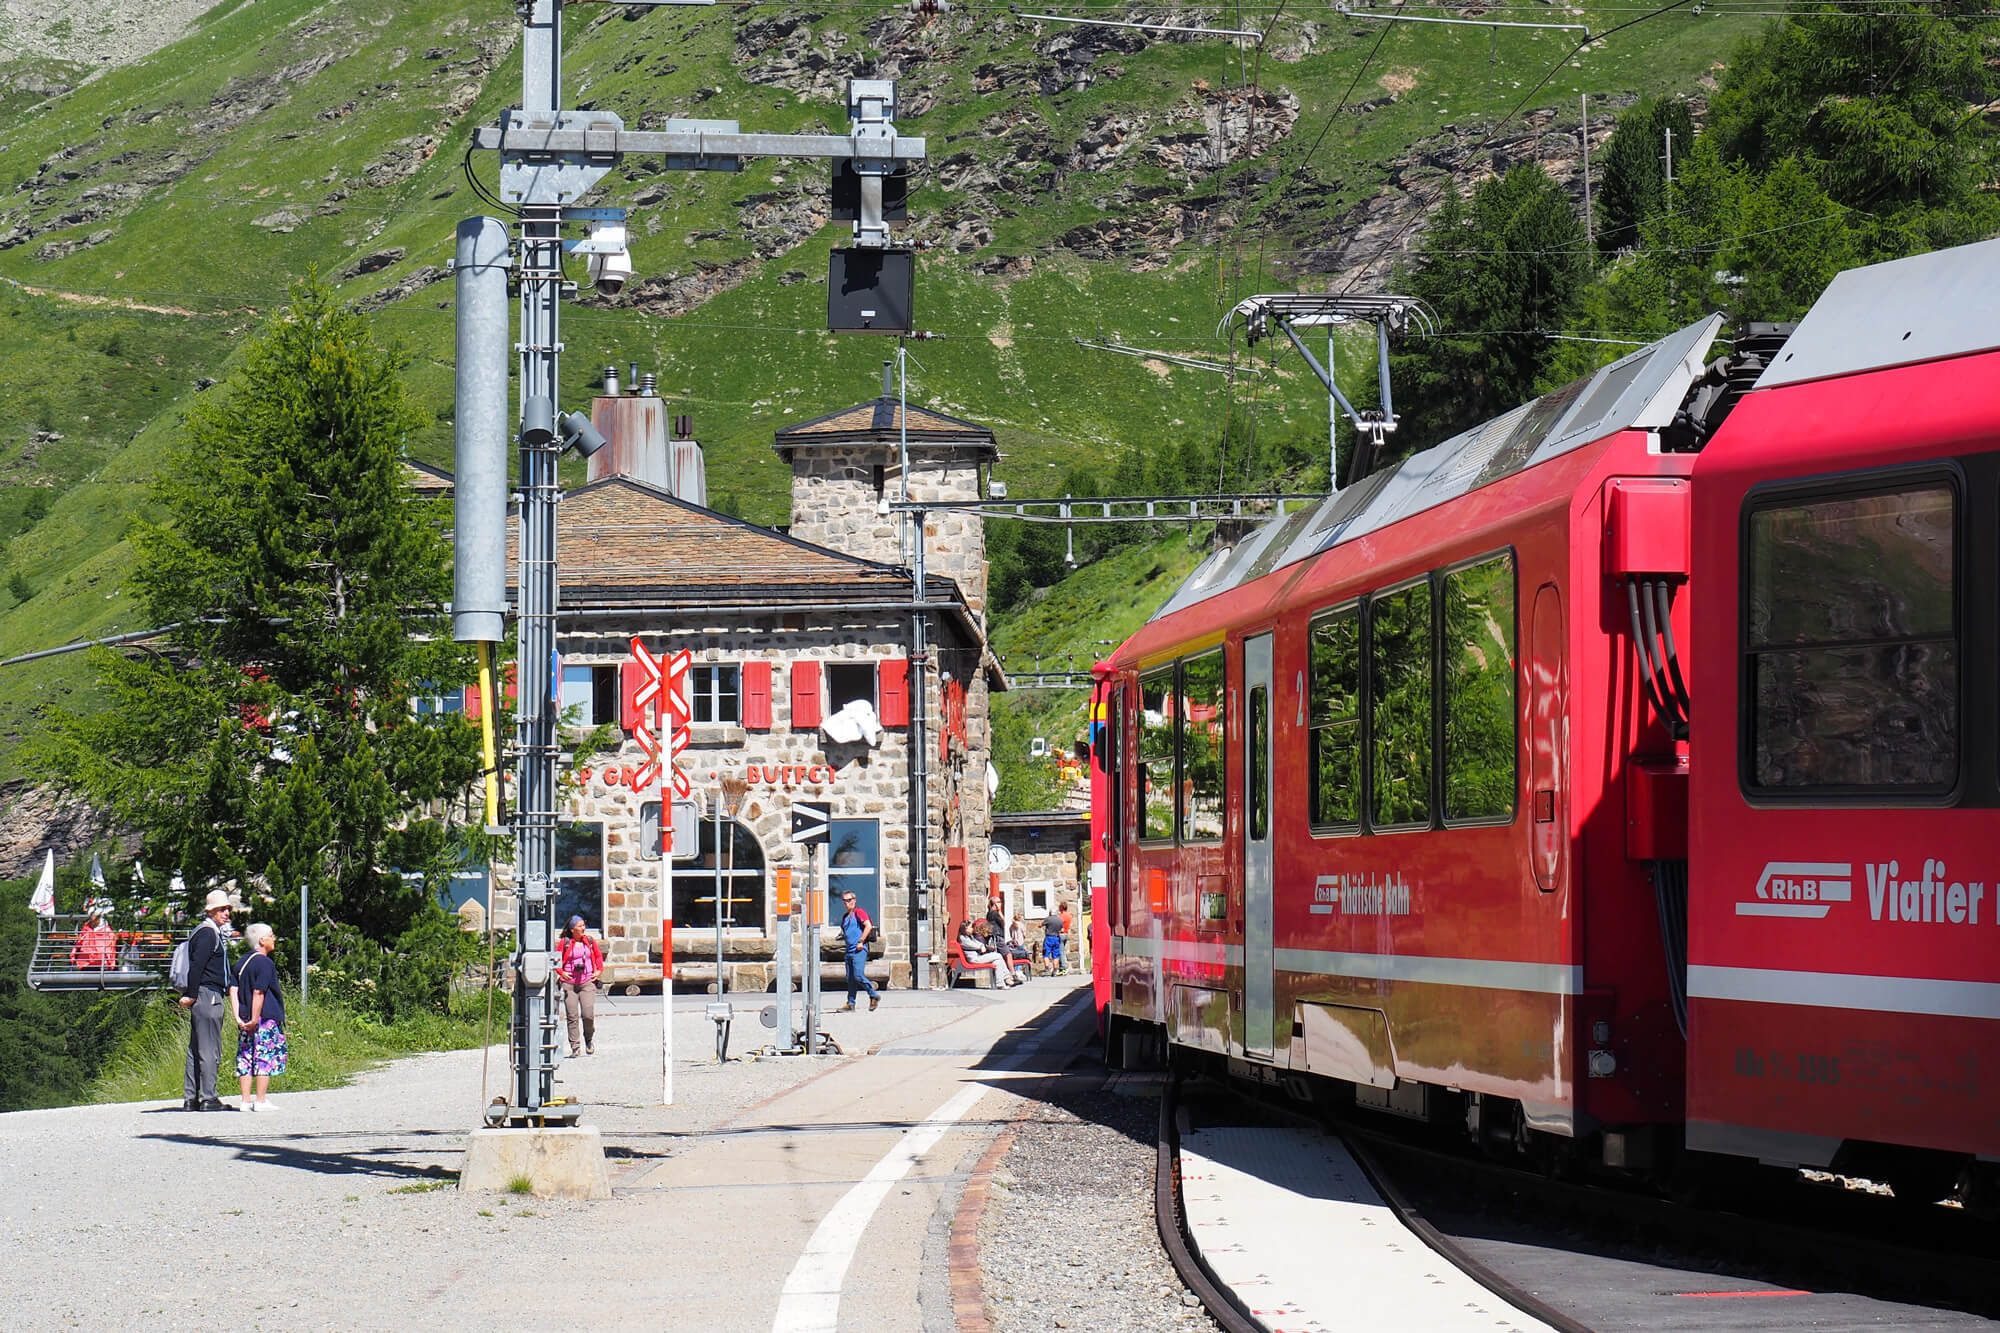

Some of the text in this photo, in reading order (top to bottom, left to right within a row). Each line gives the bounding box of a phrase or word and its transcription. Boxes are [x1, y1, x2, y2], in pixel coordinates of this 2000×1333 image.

[1296, 670, 1303, 726] 2
[603, 766, 662, 786] GR
[747, 765, 835, 784] BUFFET
[1341, 871, 1383, 915] Rhätische
[1386, 871, 1409, 915] Bahn
[1772, 879, 1817, 900] RhB
[1865, 858, 1984, 925] Viafier
